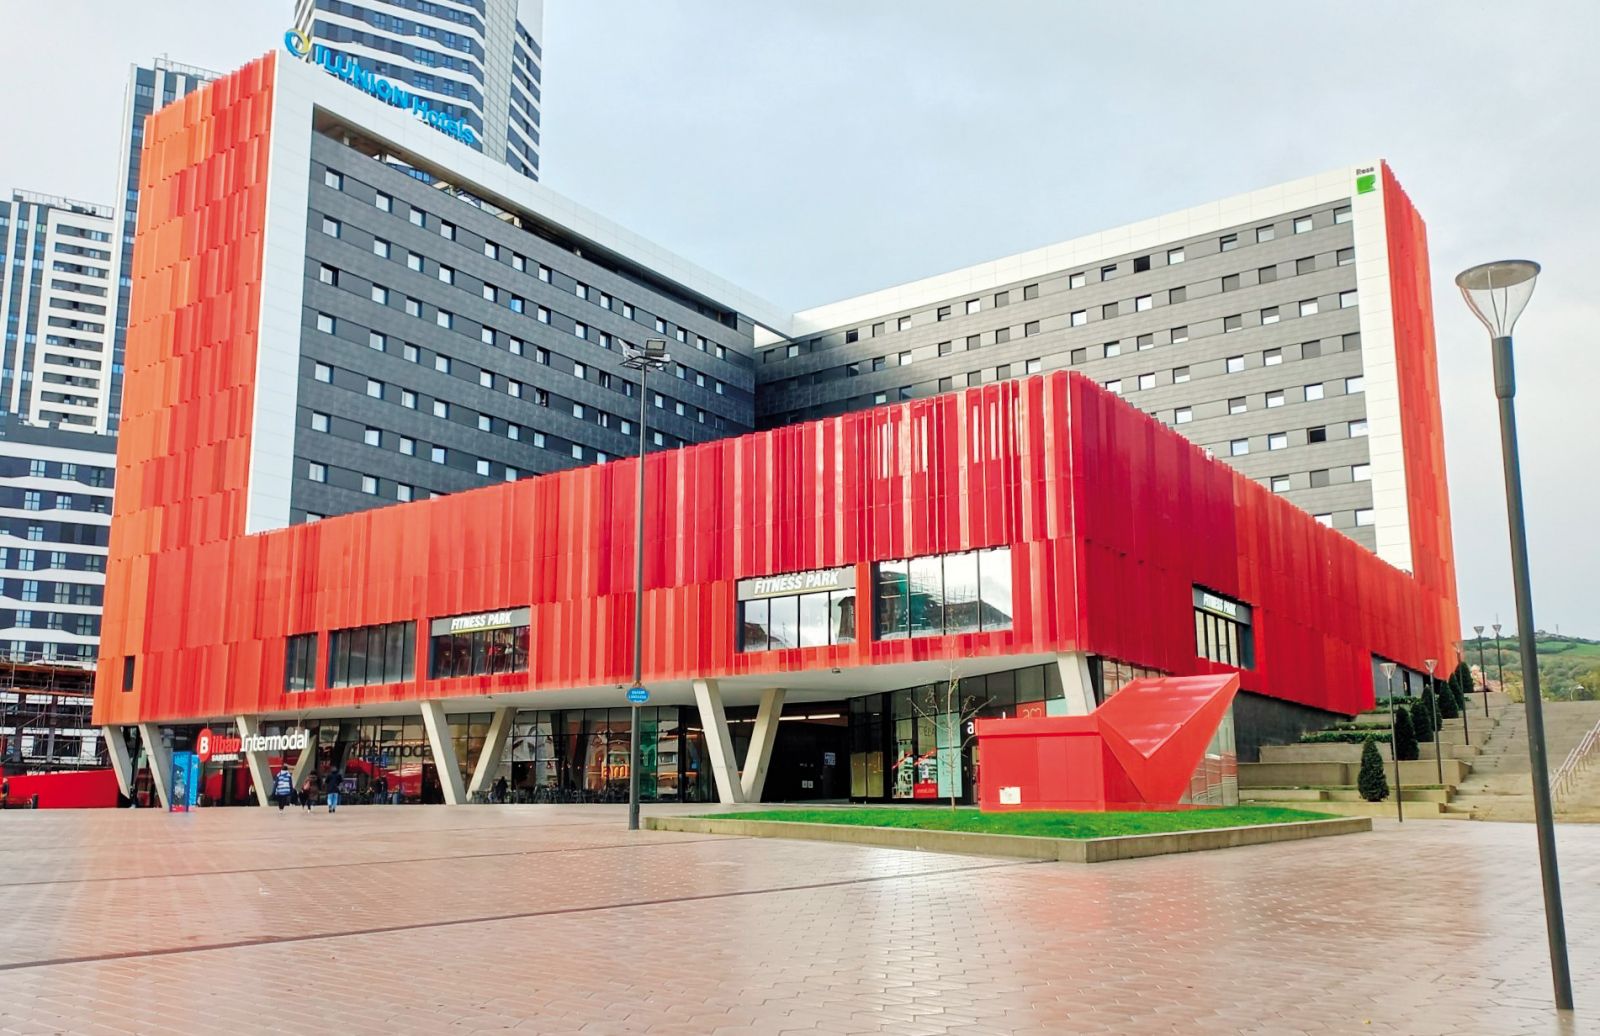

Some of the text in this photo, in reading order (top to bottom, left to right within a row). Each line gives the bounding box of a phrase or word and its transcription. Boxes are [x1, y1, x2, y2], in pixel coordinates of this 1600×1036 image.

[314, 44, 475, 145] ILUNION Hotels
[754, 571, 839, 594] FITNESS PARK
[451, 612, 512, 630] FITNESS PARK
[199, 734, 241, 755] Bilbao
[240, 728, 307, 752] Intermodal
